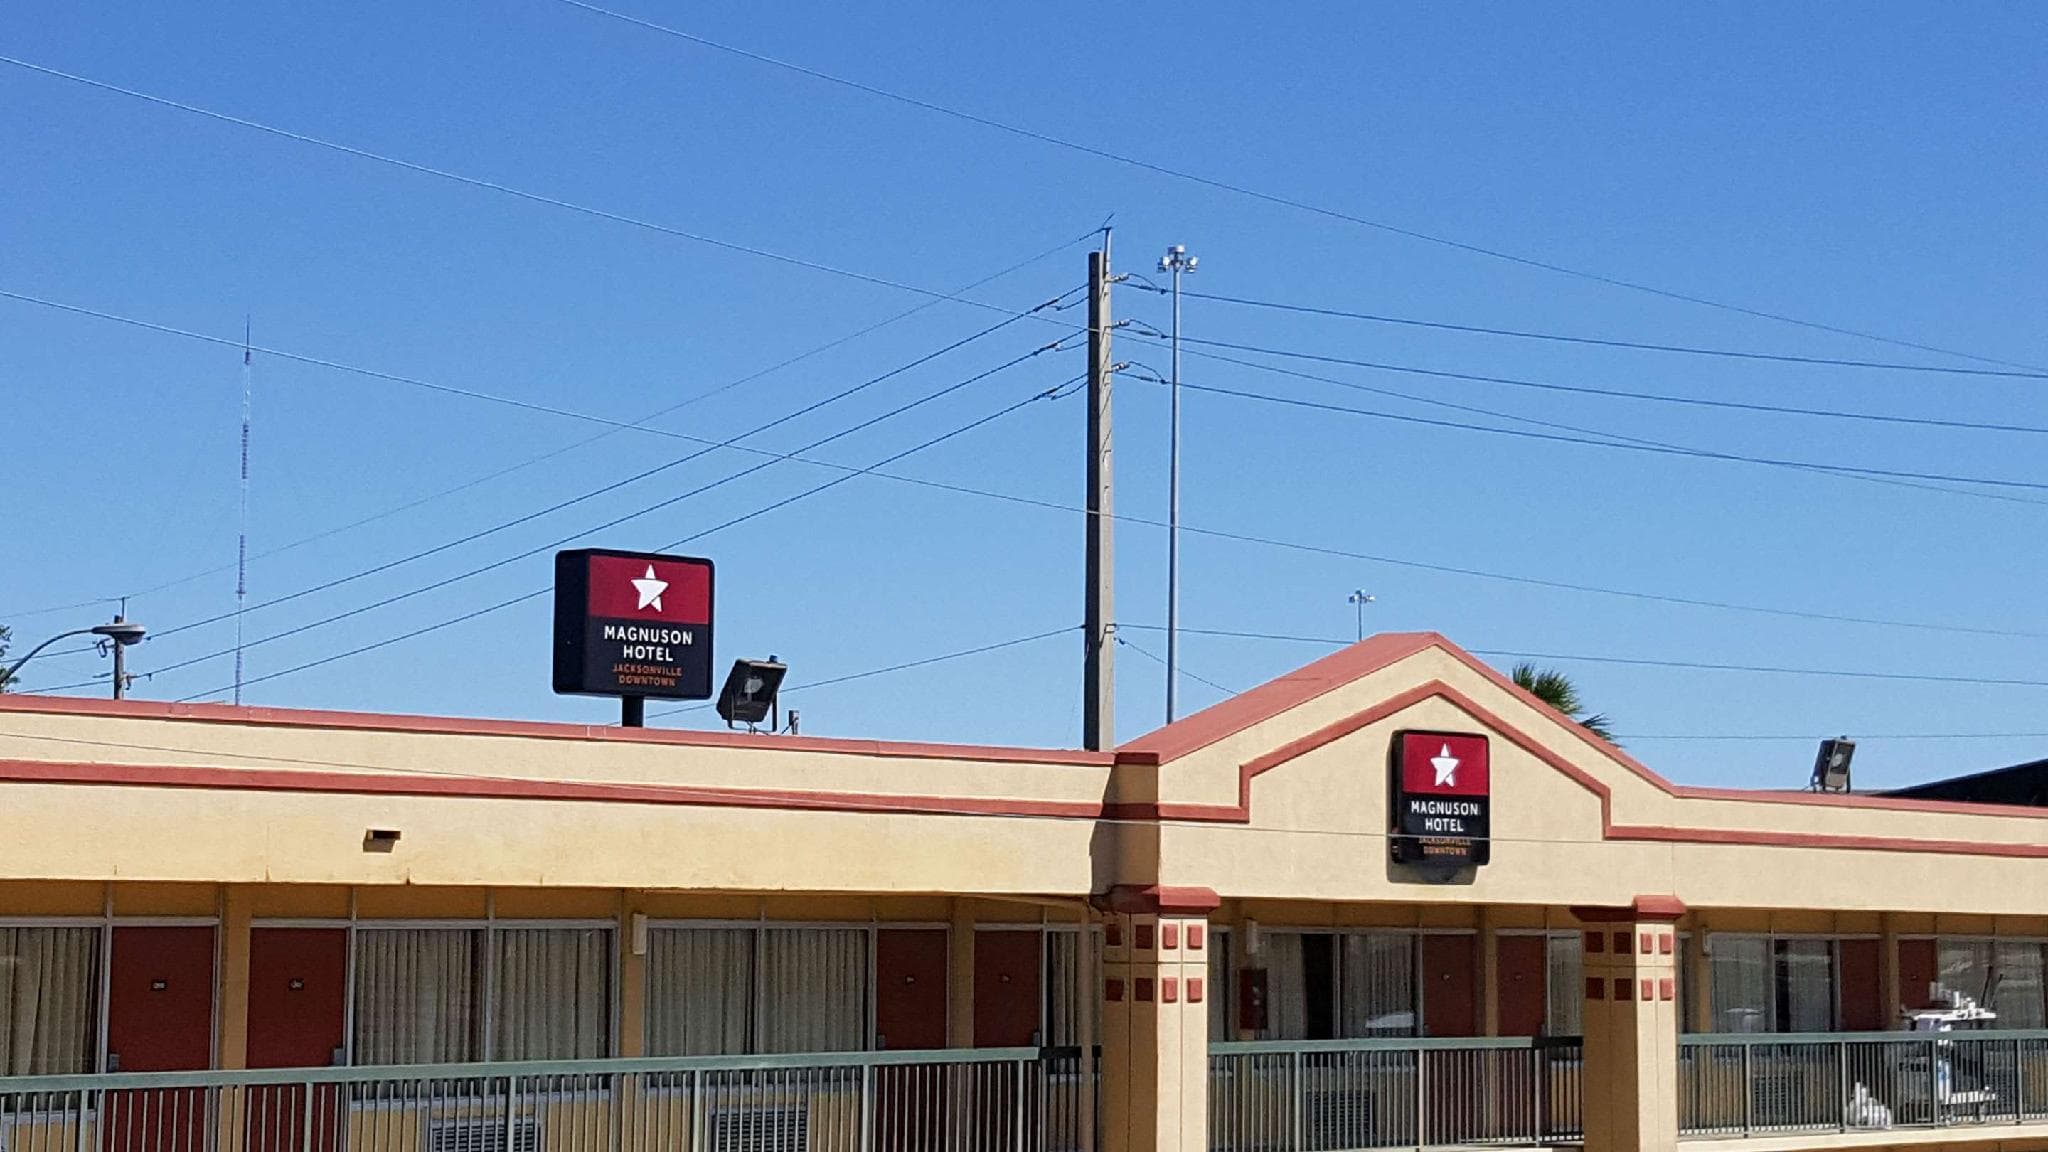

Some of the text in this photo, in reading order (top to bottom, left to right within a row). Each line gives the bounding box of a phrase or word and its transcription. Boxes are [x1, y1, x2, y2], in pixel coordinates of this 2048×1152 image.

[604, 625, 692, 645] MAGNUSON
[623, 644, 674, 662] HOTEL
[613, 664, 682, 676] JACKSONVILLE
[619, 675, 676, 686] DOWNTOWN
[1411, 801, 1479, 816] MAGNUSON
[1425, 817, 1464, 832] HOTEL
